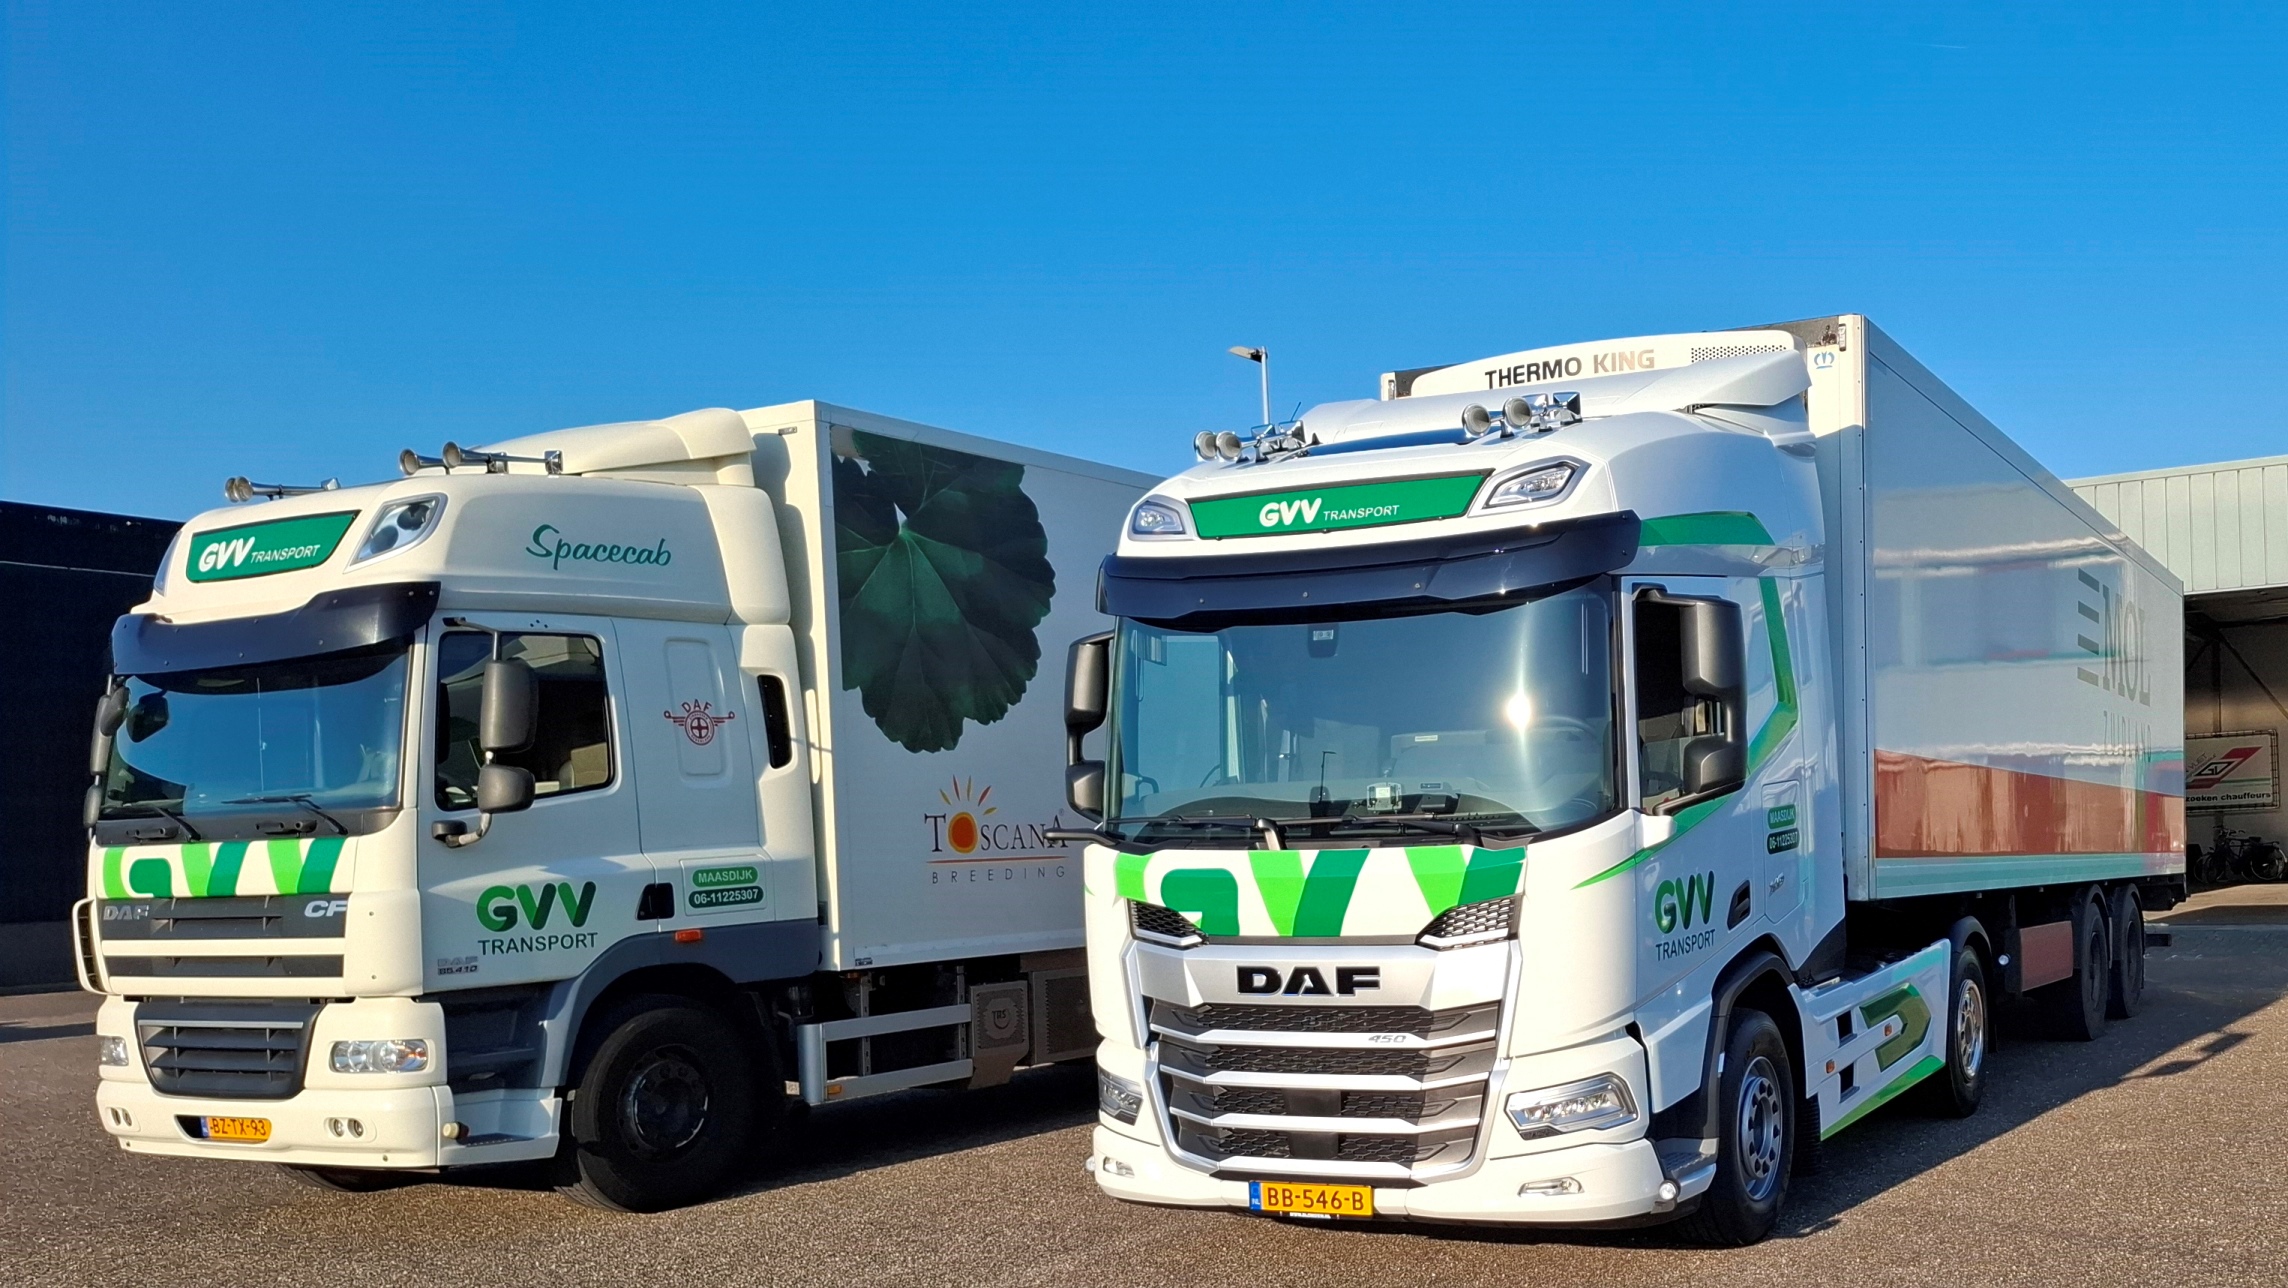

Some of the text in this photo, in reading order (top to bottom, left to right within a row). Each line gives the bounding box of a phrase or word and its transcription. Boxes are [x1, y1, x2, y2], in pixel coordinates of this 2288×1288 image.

[1485, 349, 1655, 390] THERMO KING
[1259, 497, 1400, 527] GVV TRANSPORT
[198, 536, 321, 572] GVV TRANSPORT
[525, 524, 671, 571] Spacecab
[681, 699, 712, 713] DAF
[2220, 792, 2271, 801] chauffeurs
[698, 869, 753, 884] MAASDIJK
[932, 865, 1065, 884] BREEDING
[304, 900, 347, 918] CF
[476, 881, 597, 932] GVV
[693, 889, 759, 905] 06-11225307
[1655, 870, 1715, 934] GVV
[103, 904, 150, 921] DAF
[478, 932, 598, 956] TRANSPORT
[1655, 928, 1716, 961] TRANSPORT
[1237, 965, 1381, 997] DAF
[1368, 1034, 1407, 1044] 450
[212, 1118, 267, 1136] BZ-TX-93
[1267, 1187, 1364, 1211] BB-546-B
